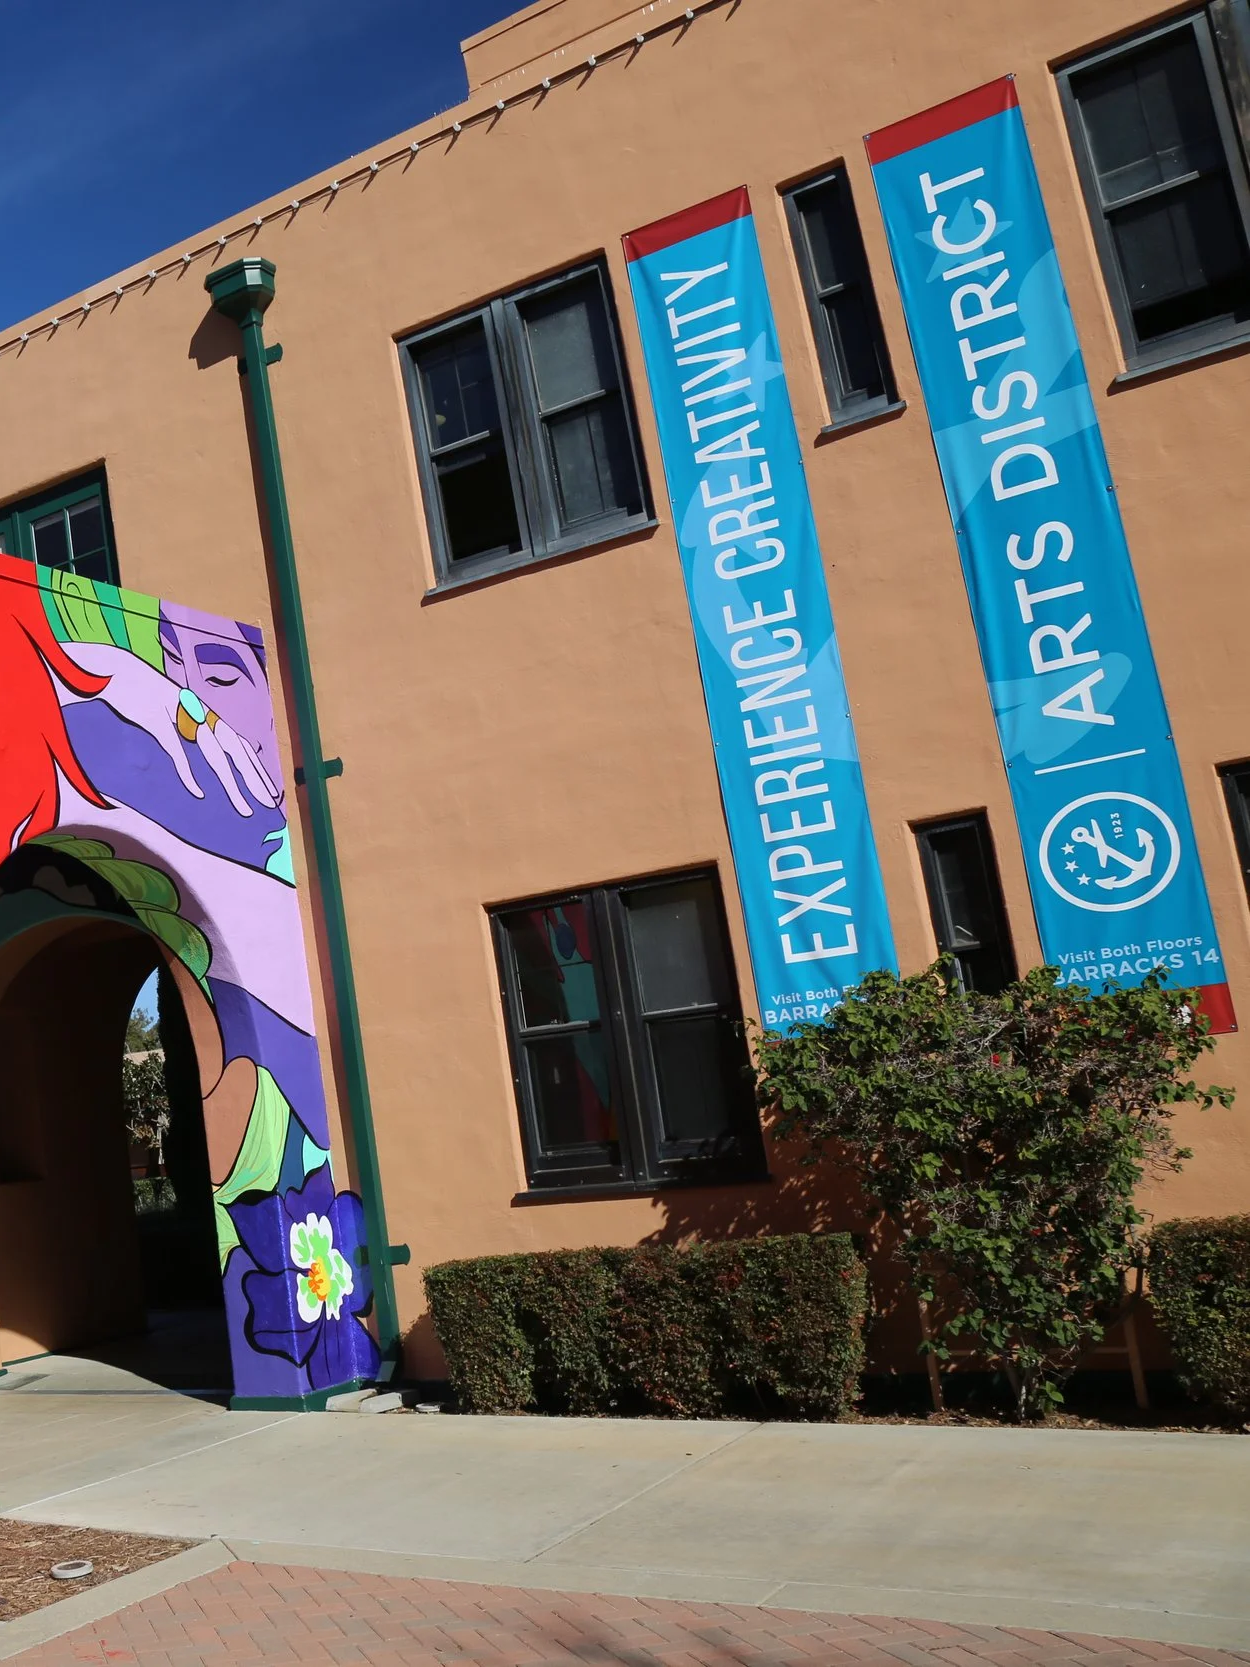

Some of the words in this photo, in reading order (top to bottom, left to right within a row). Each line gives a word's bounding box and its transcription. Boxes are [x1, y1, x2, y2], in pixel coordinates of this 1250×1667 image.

[919, 166, 1060, 502] DISTRICT
[660, 261, 786, 580] CREATIVITY
[1006, 520, 1115, 726] ARTS
[723, 588, 859, 965] EXPERIENCE
[1109, 812, 1125, 839] 1923
[771, 992, 802, 1006] Visit
[805, 987, 839, 1001] Both
[1057, 950, 1096, 965] Visit
[1100, 943, 1142, 960] Both
[1146, 936, 1203, 950] Floors
[1191, 948, 1220, 966] 14
